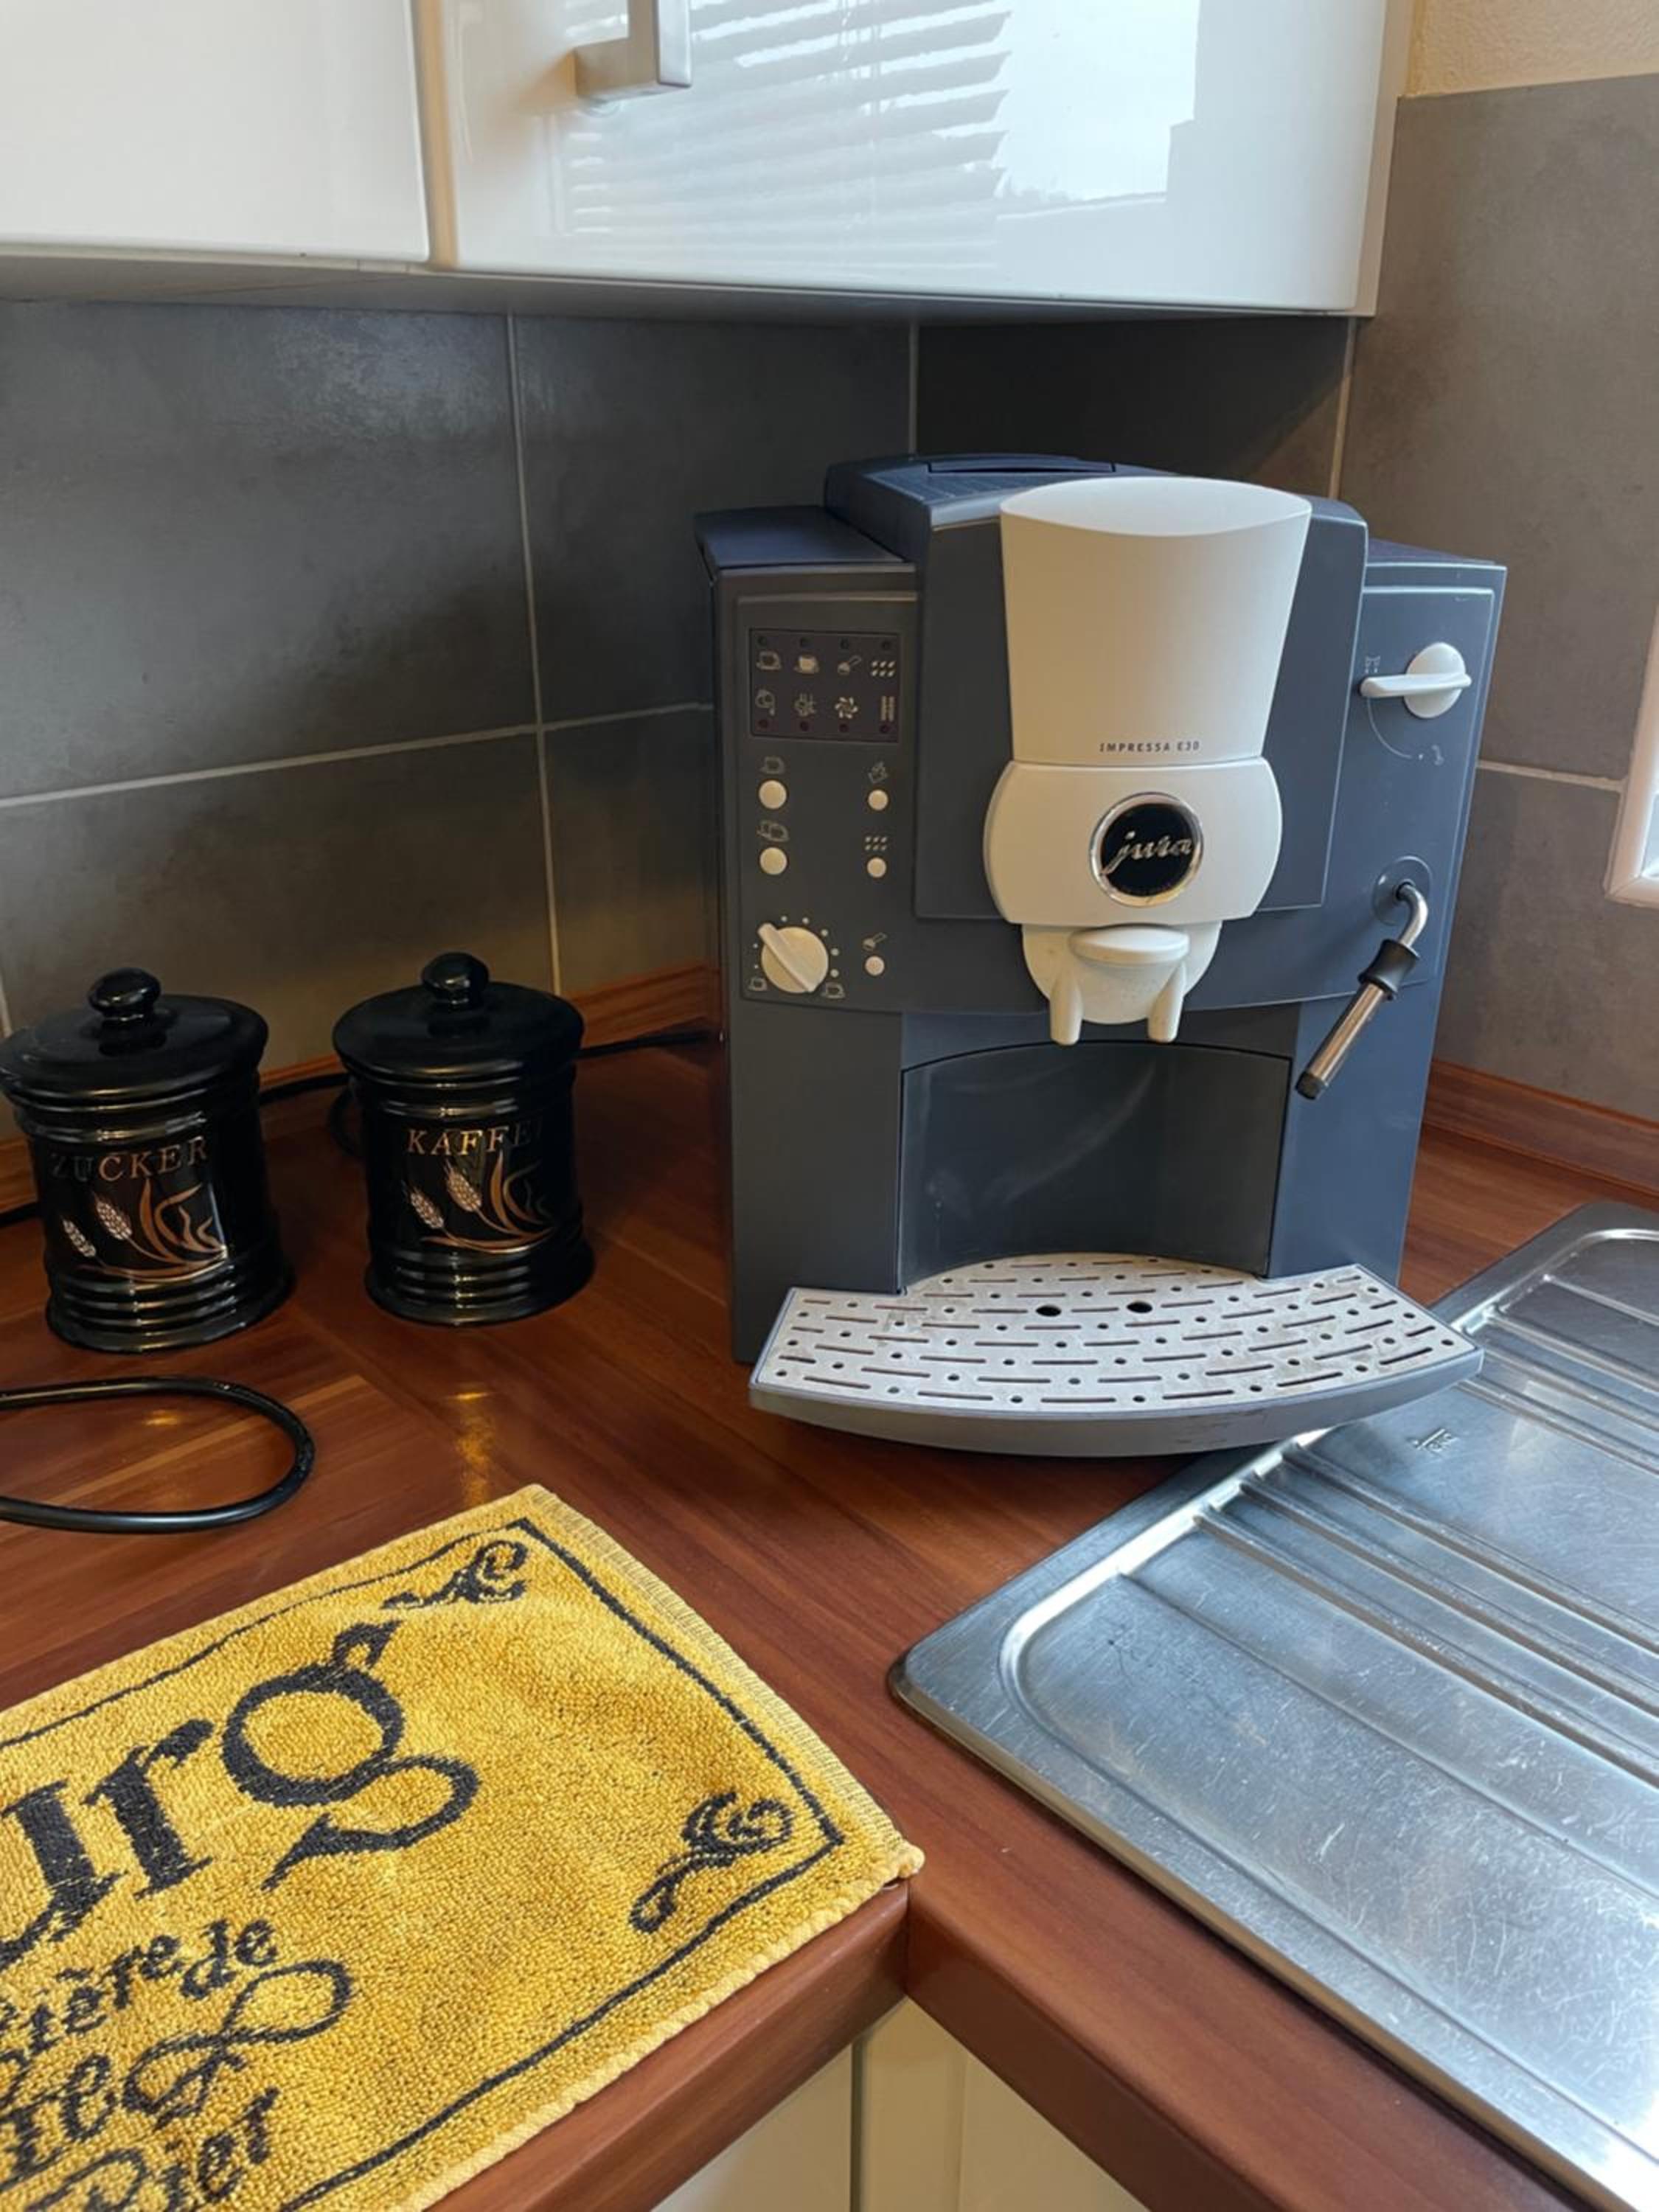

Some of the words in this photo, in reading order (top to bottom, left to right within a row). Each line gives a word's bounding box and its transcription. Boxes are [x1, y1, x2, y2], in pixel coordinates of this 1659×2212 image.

[1099, 742, 1170, 753] IMPRESSA
[49, 1134, 208, 1182] ZUCKER
[407, 1119, 542, 1156] KAFFE
[179, 1918, 279, 2002] de
